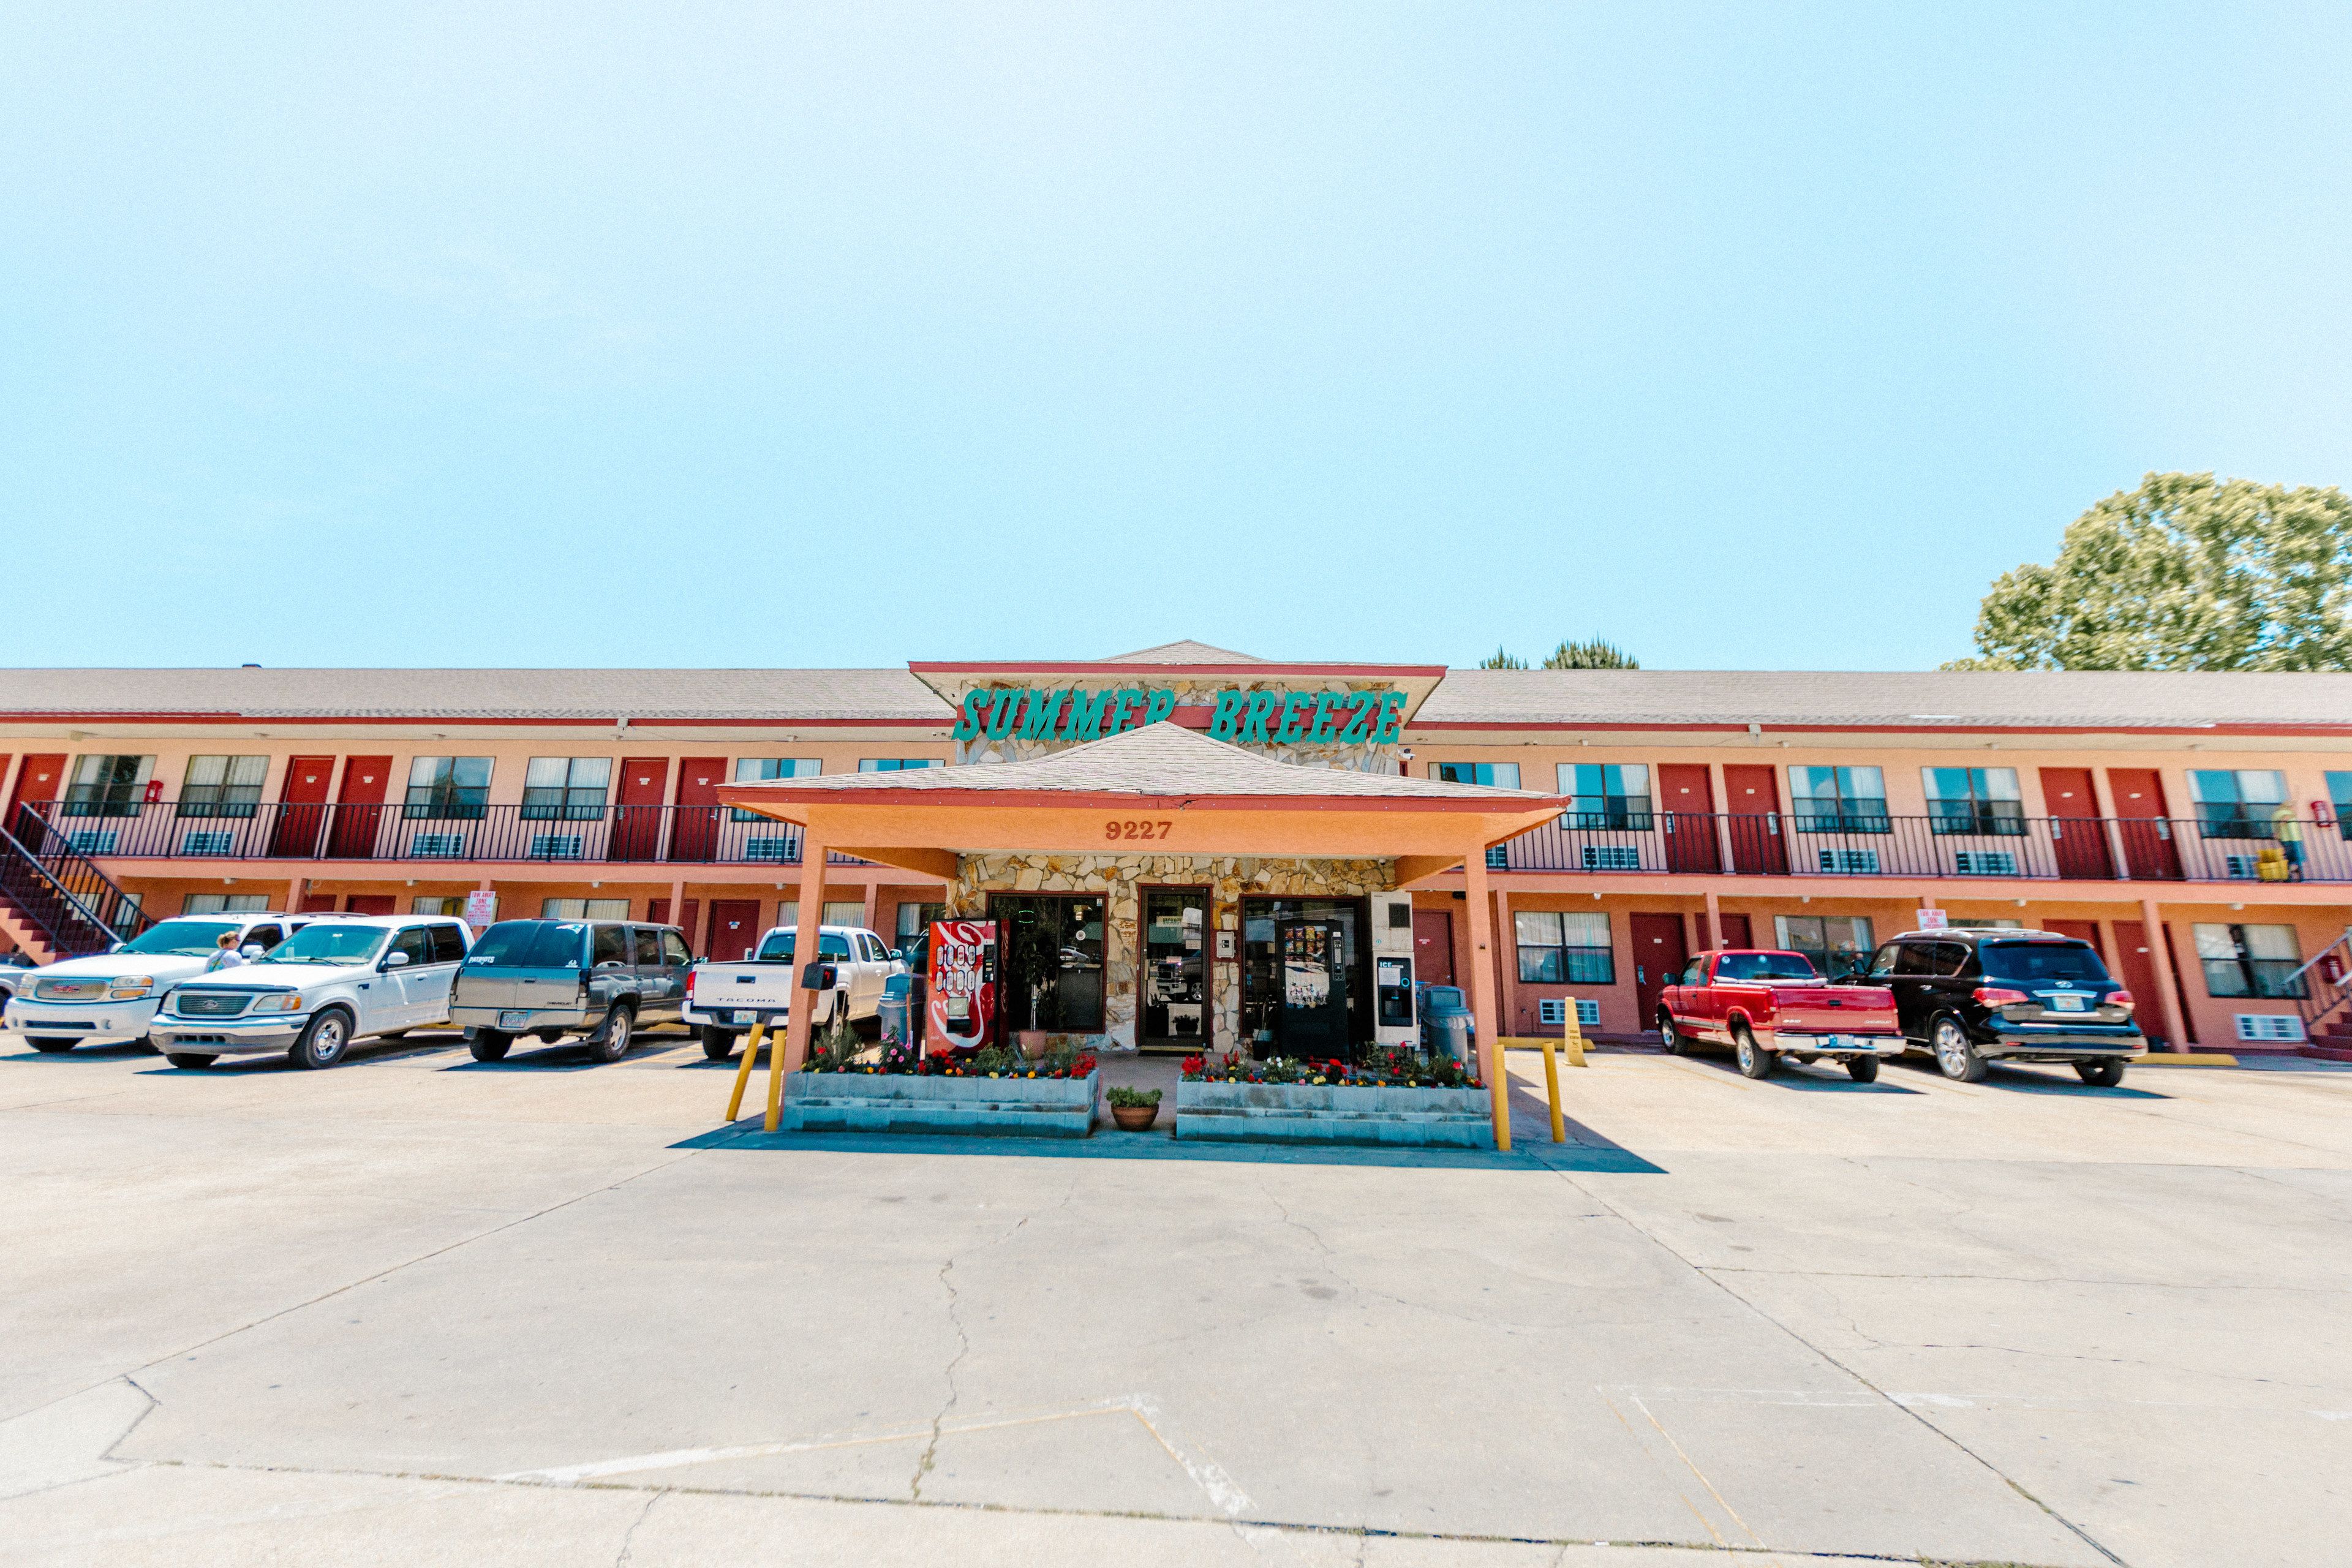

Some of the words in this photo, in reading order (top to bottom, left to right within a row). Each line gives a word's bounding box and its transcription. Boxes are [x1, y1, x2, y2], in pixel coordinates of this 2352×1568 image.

[954, 688, 1177, 742] SUMMER
[1207, 690, 1409, 745] BREEZE
[1105, 821, 1172, 840] 9227
[468, 956, 495, 965] PATRIOTS
